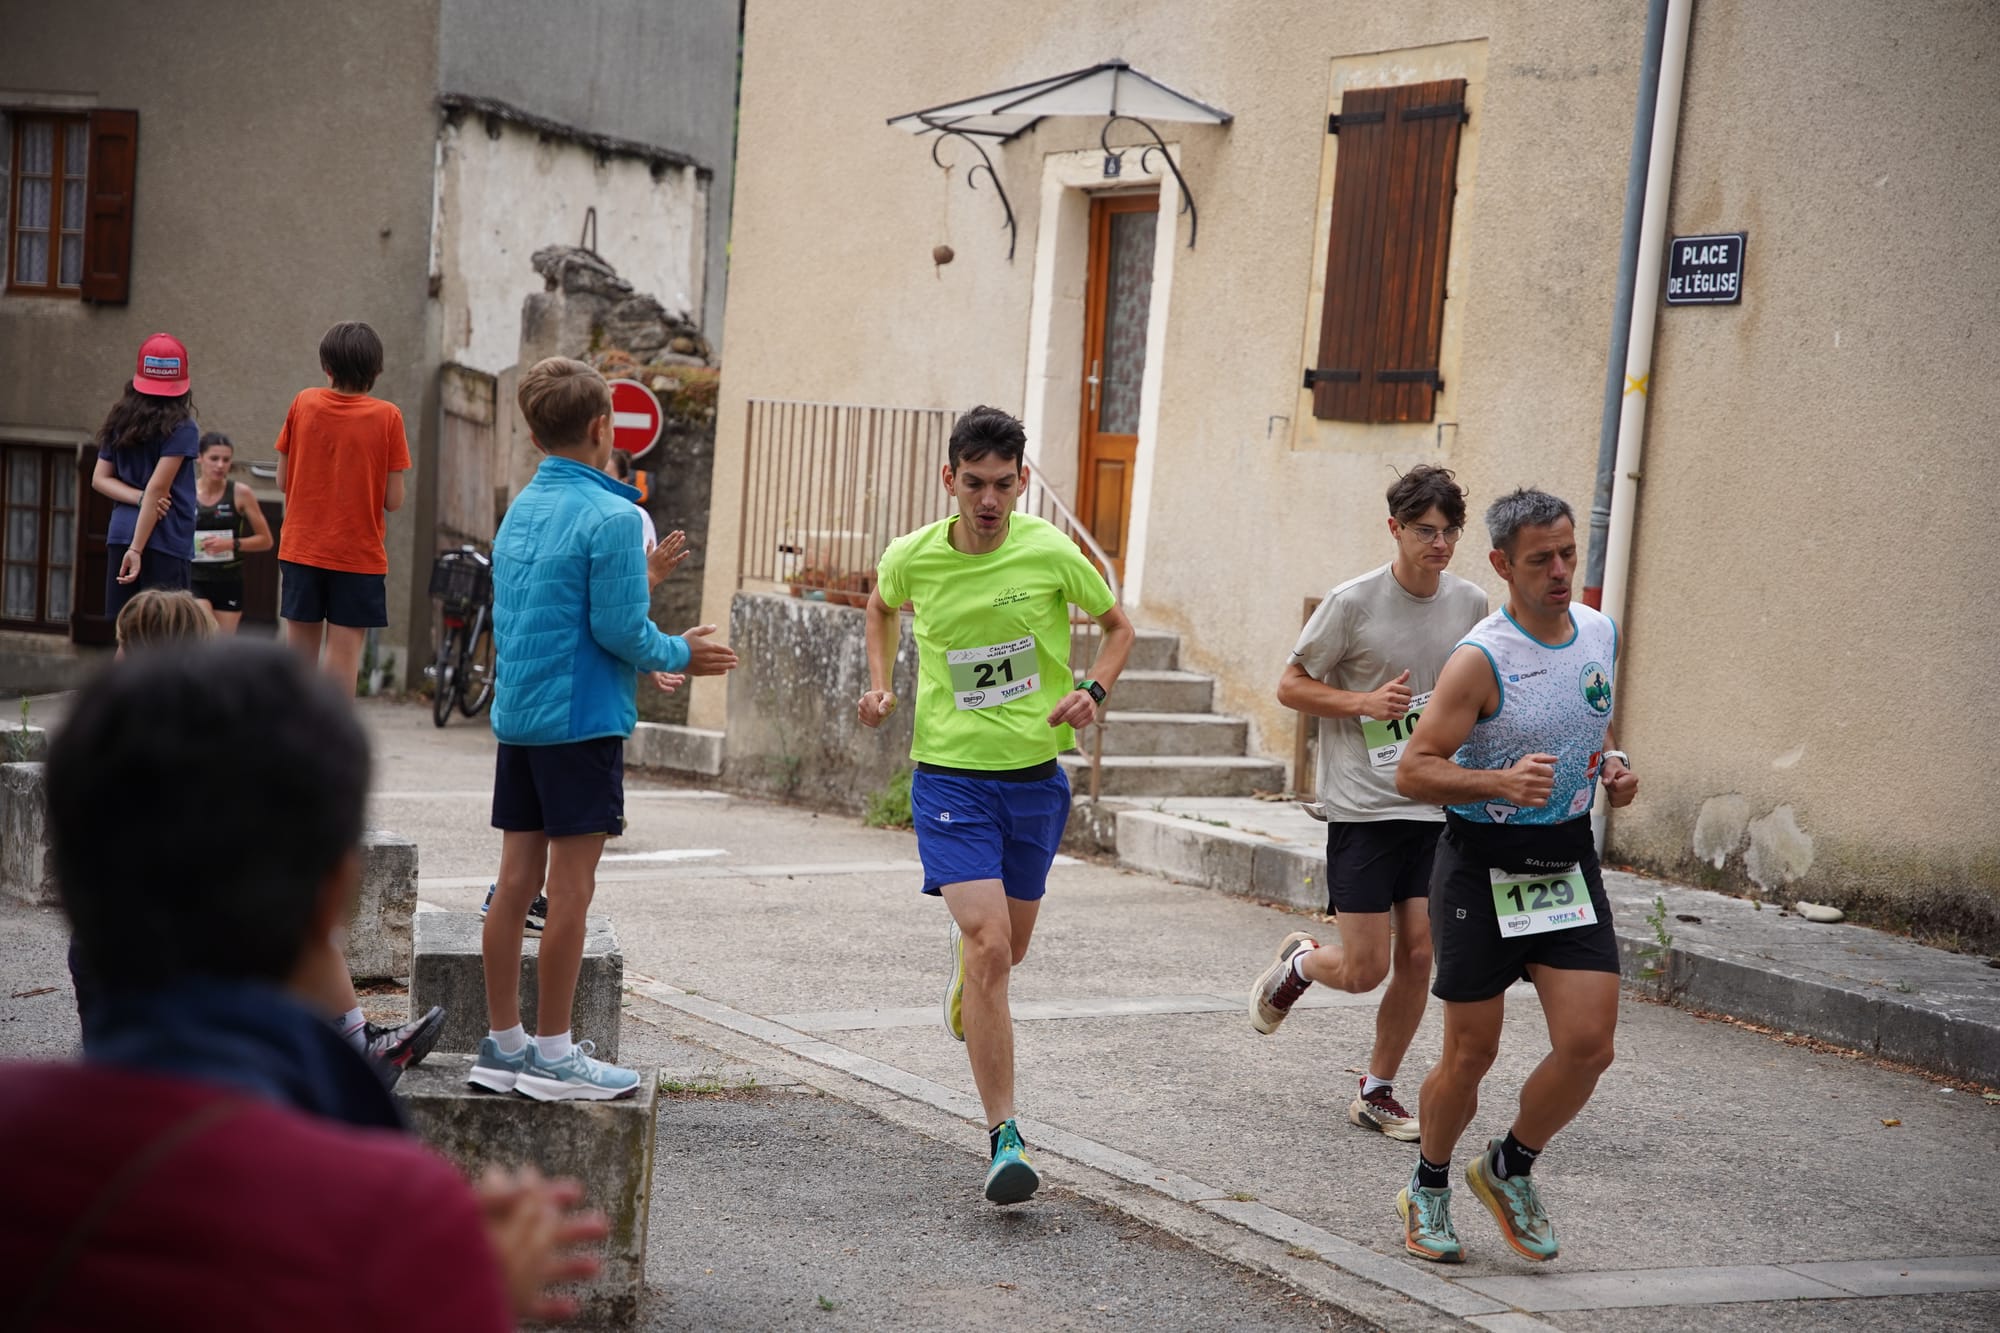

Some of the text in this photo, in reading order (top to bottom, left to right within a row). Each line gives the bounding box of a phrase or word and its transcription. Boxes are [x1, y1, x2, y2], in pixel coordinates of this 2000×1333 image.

[1682, 245, 1729, 266] PLACE
[1669, 269, 1737, 294] DE L'ÉGLISE
[973, 658, 1014, 689] 21
[1507, 880, 1575, 913] 129
[1547, 914, 1577, 923] TUFF'S
